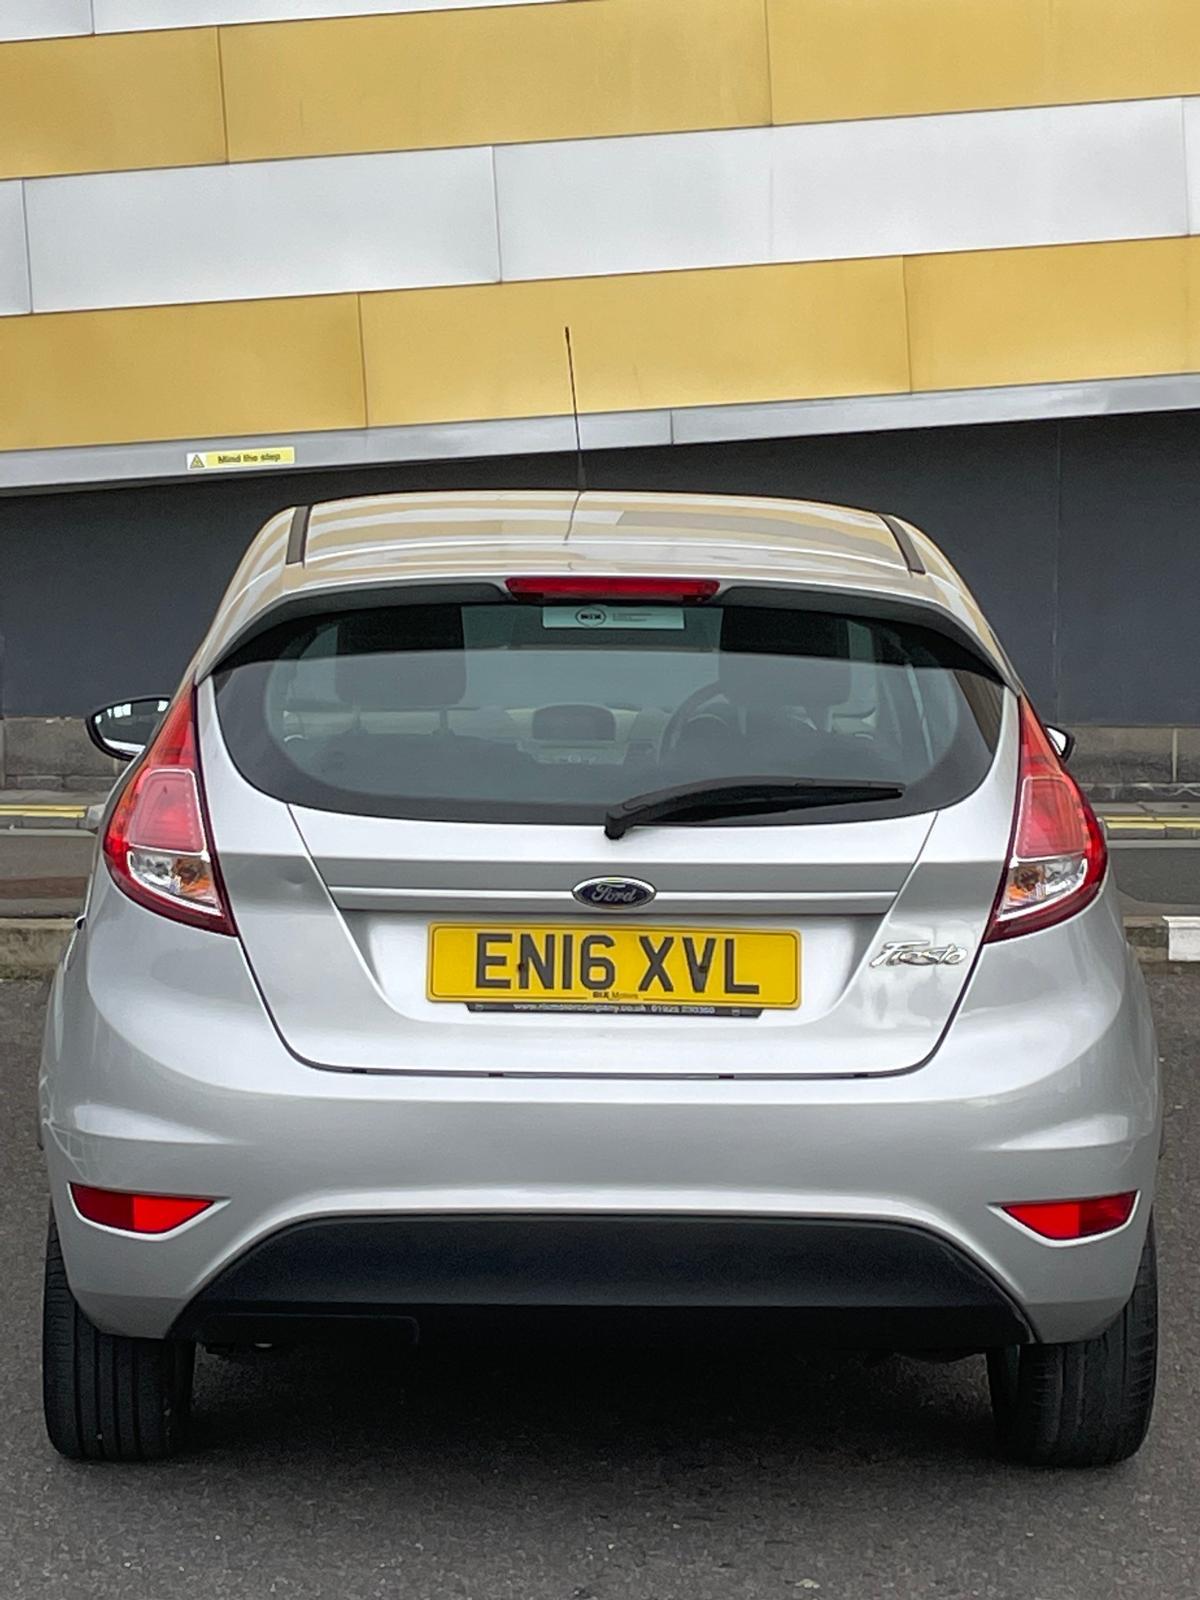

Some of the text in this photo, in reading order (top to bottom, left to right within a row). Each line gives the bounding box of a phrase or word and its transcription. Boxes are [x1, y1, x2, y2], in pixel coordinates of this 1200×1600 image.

[218, 452, 281, 464] Mind the step
[591, 883, 637, 902] Ford
[475, 932, 760, 995] EN16 XVL
[869, 940, 968, 968] Fiesta
